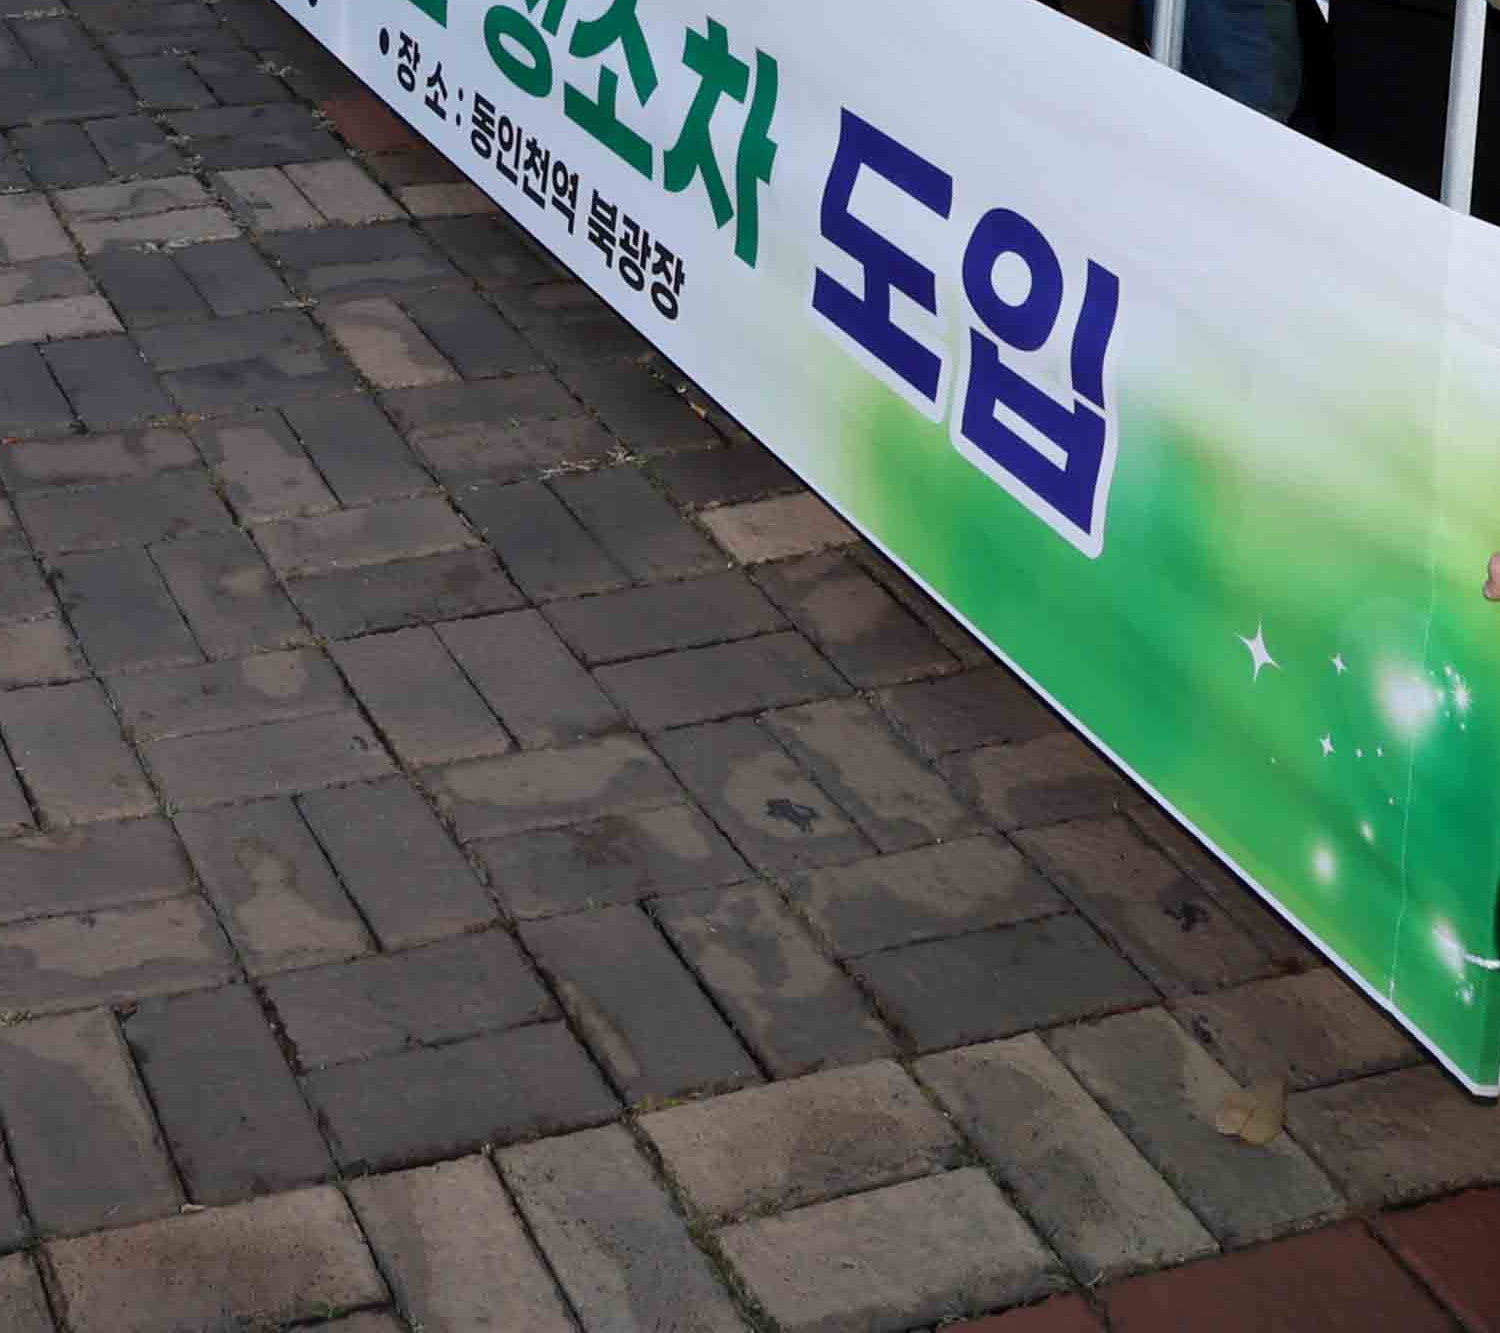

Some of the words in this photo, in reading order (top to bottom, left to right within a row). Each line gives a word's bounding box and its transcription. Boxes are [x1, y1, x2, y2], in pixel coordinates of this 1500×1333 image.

[470, 92, 580, 235] 동인천역
[586, 188, 686, 321] 북광장
[812, 106, 1120, 536] 도입
